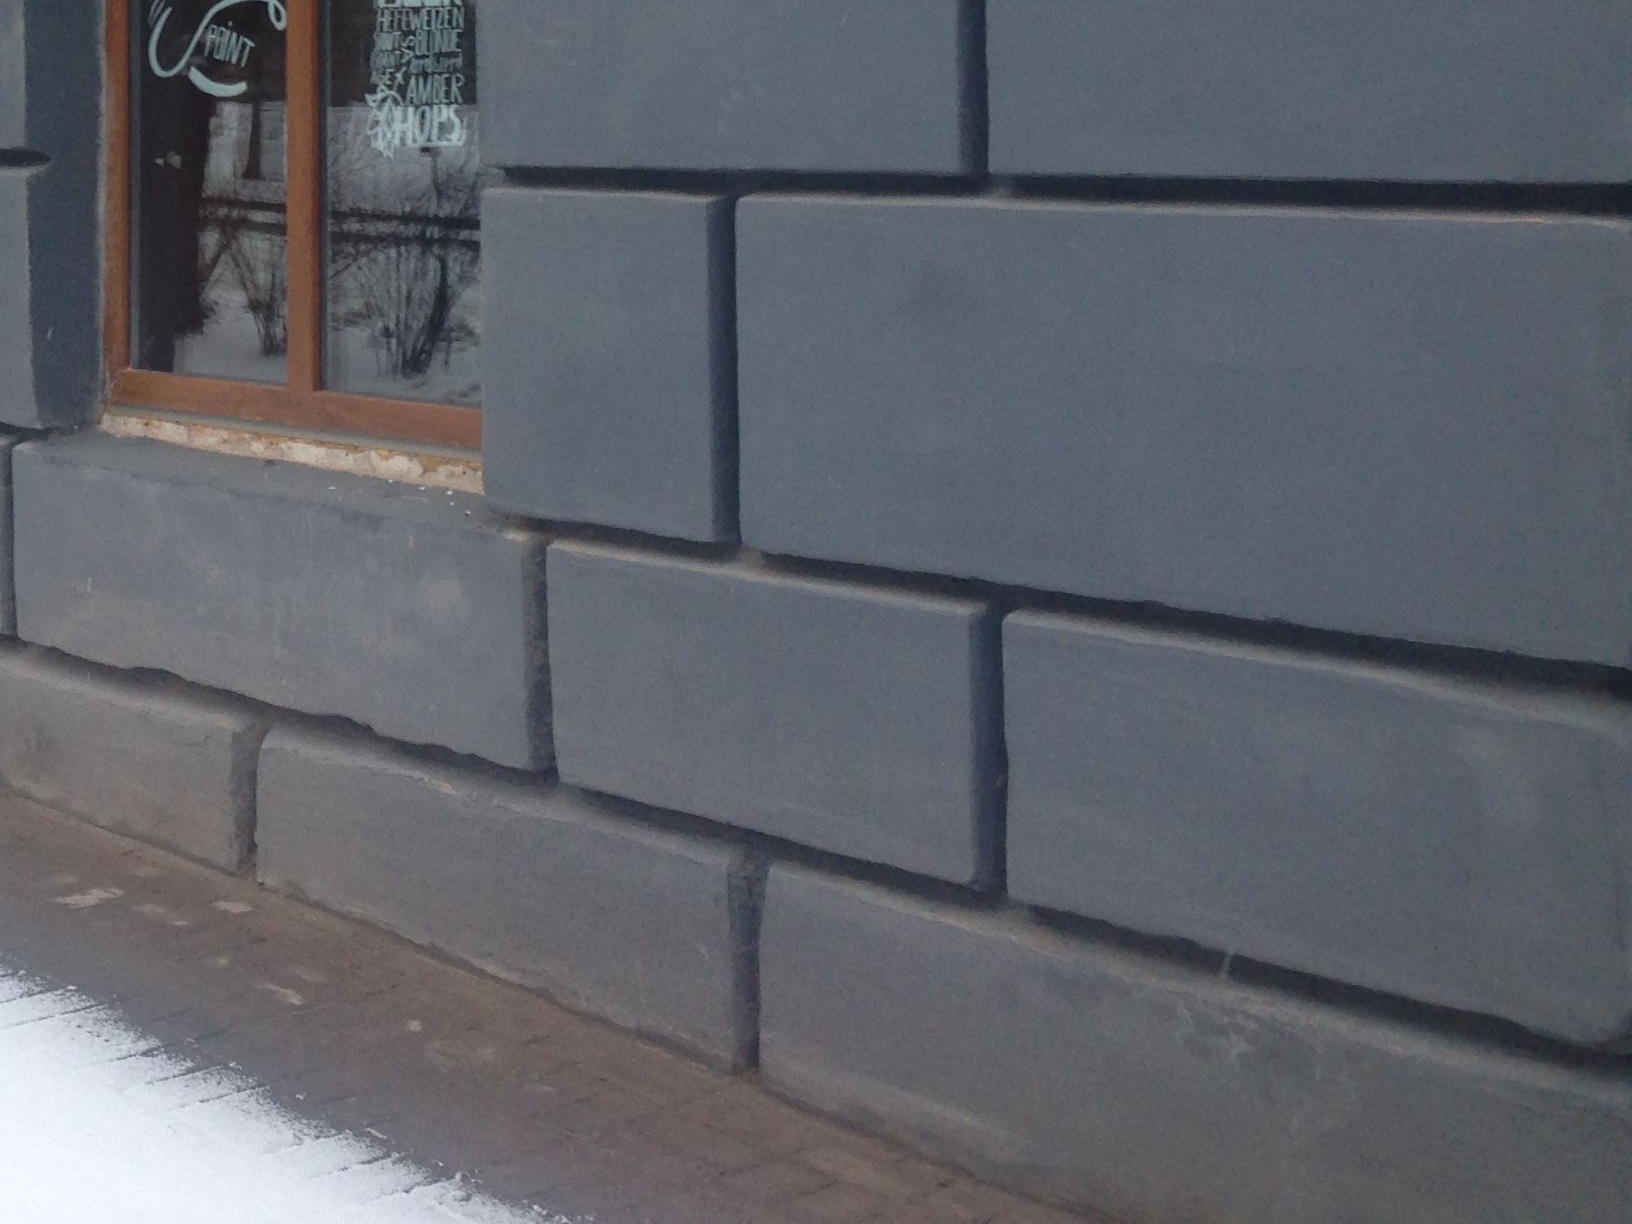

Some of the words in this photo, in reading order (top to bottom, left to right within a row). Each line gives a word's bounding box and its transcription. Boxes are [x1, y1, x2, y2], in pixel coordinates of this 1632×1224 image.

[376, 6, 465, 33] HEFEWEIZEN
[405, 73, 466, 105] AMBER
[393, 104, 463, 146] HOPS
